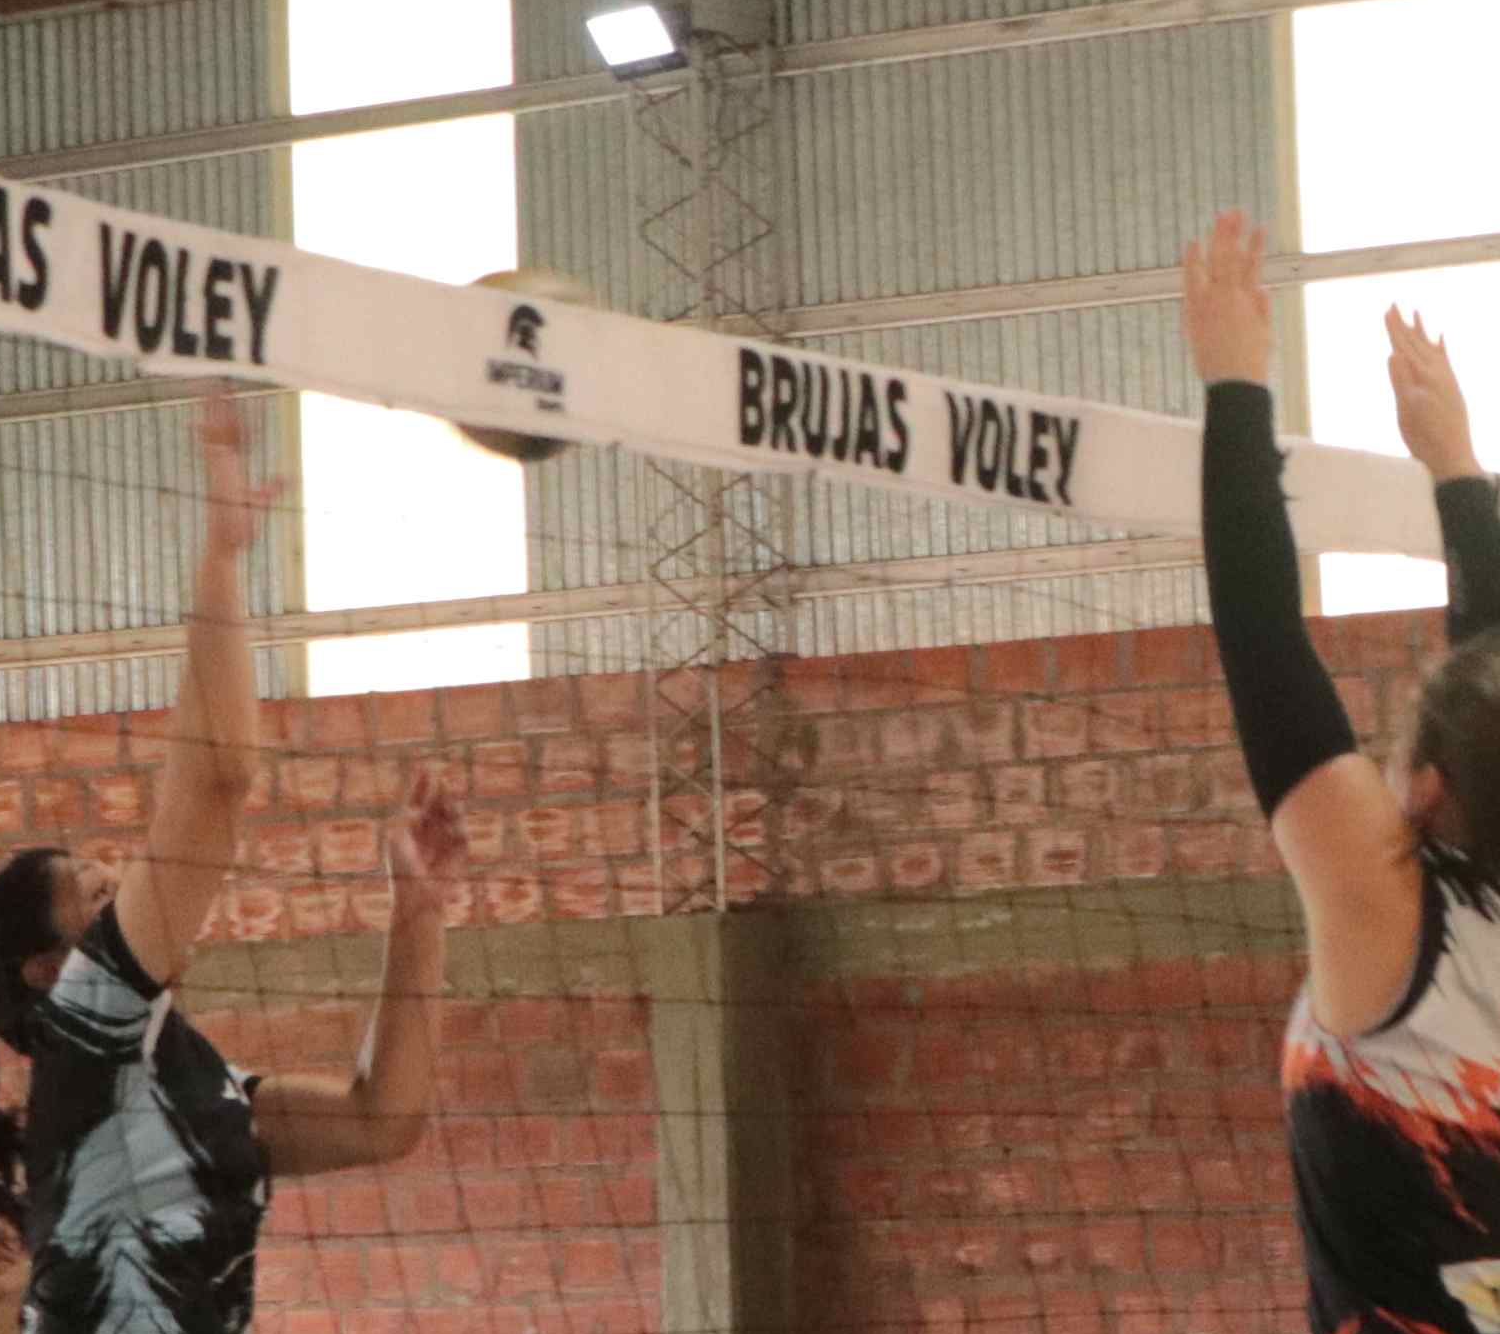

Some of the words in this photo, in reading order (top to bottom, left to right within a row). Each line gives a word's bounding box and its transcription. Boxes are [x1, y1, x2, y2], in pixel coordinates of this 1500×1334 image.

[100, 224, 280, 365] VOLEY
[738, 348, 909, 474] BRUJAS
[945, 390, 1081, 505] VOLEY
